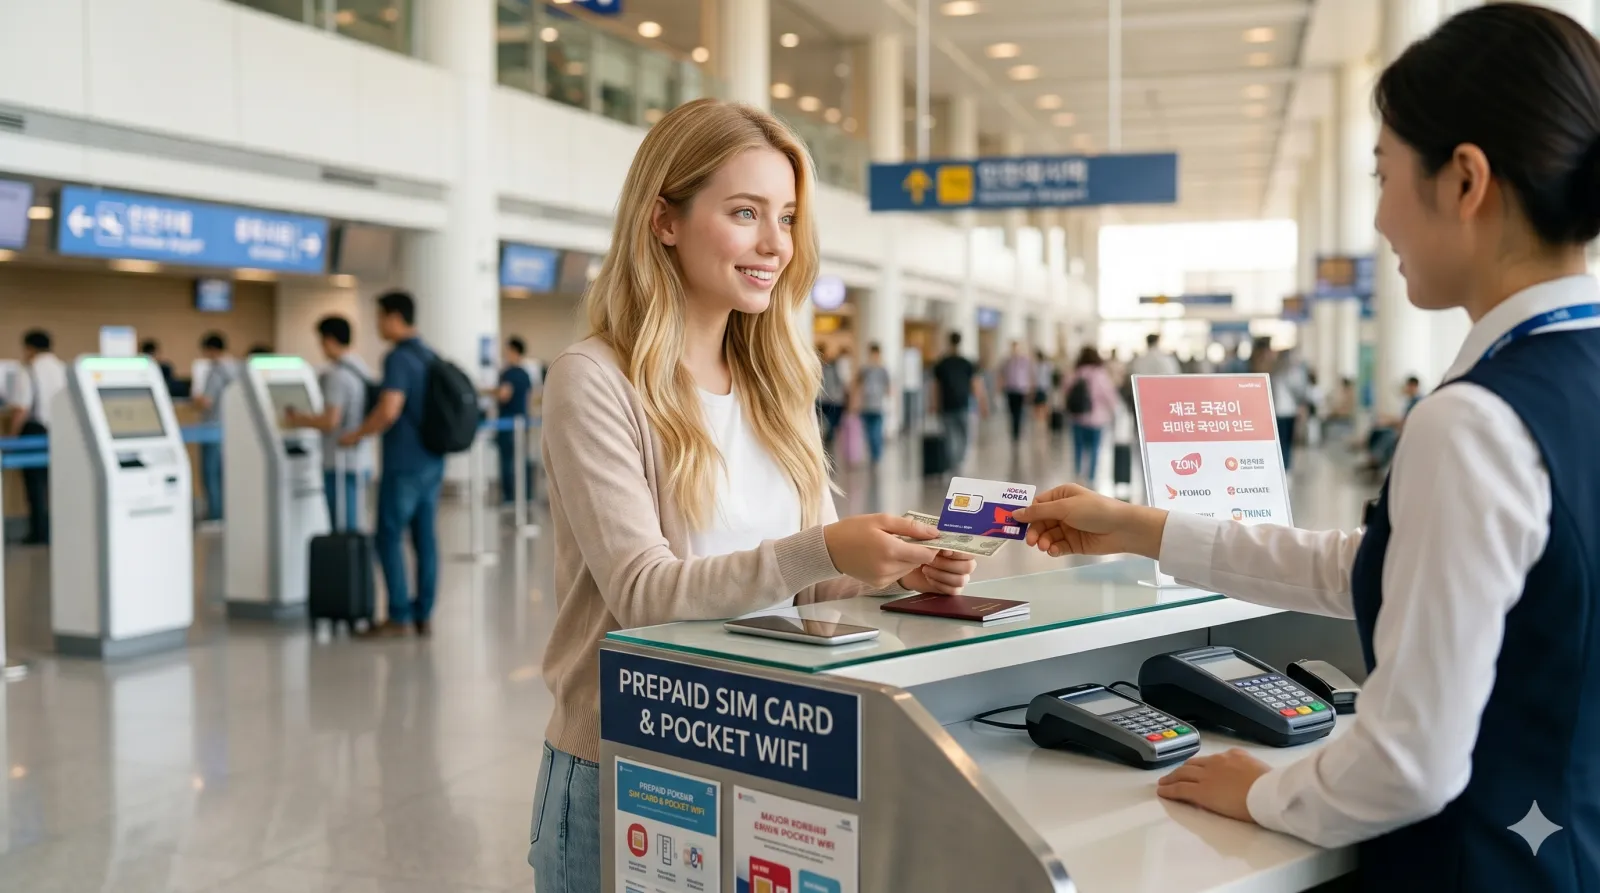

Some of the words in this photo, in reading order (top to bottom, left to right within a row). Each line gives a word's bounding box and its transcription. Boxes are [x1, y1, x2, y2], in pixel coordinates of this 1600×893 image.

[1001, 492, 1028, 502] KOREA
[619, 667, 710, 710] PREPAID
[715, 687, 758, 721] SIM
[764, 697, 833, 736] CARD
[639, 708, 656, 737] &
[660, 712, 750, 757] POCKET
[755, 733, 808, 772] WIFI
[639, 781, 667, 796] PREPAID
[628, 789, 640, 798] SIM
[641, 792, 659, 804] CARD
[665, 798, 689, 812] POCKET
[690, 804, 705, 816] WIFI
[760, 811, 790, 826] MAJOR
[781, 828, 815, 846] POCKET
